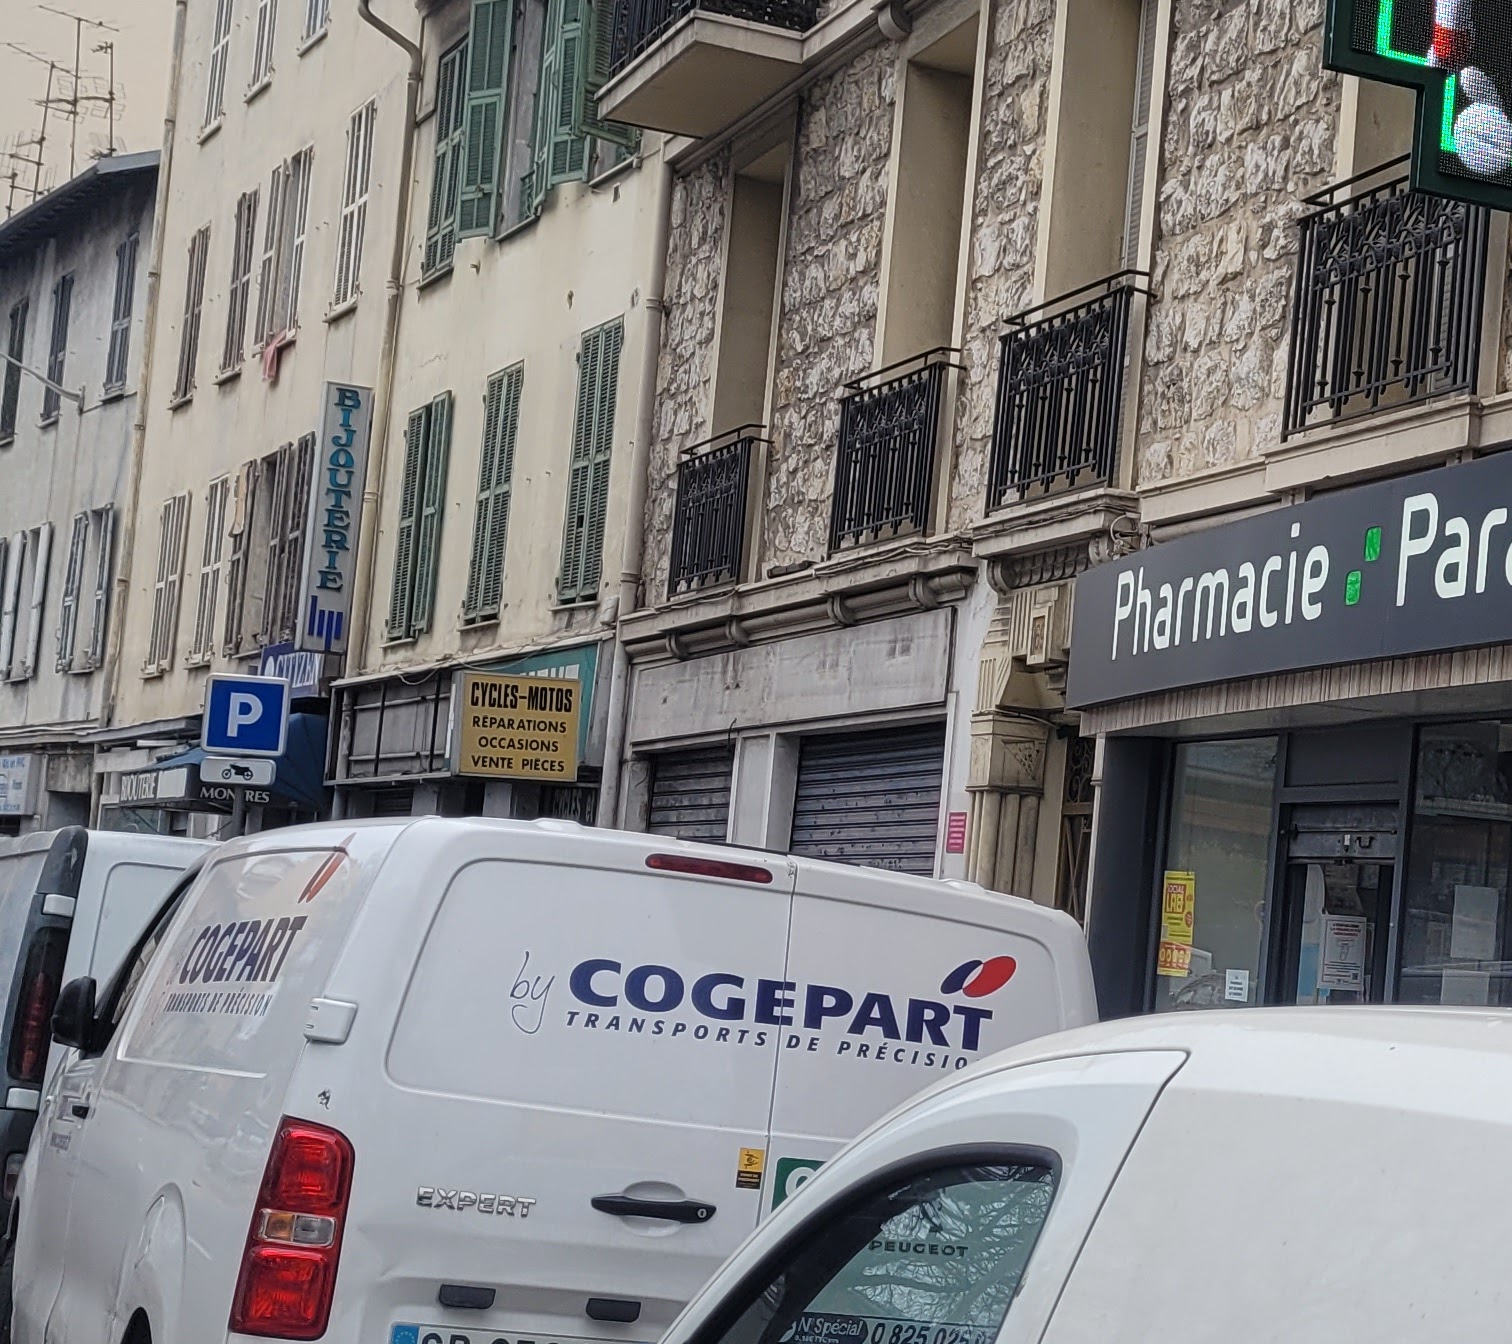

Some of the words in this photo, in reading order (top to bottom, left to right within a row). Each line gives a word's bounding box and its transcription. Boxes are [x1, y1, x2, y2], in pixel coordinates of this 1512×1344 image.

[316, 387, 361, 593] BIJOUTERIE
[1111, 522, 1328, 661] Pharmacie
[470, 681, 573, 713] CYCLES-MOTOS
[226, 691, 263, 738] P
[472, 715, 567, 733] RÉPARATIONS
[478, 736, 559, 753] OCCASIONS
[471, 754, 514, 770] VENTE
[120, 772, 157, 802] BIJOUTERIE
[200, 786, 271, 804] MONRES
[178, 915, 309, 985] COGEPART
[509, 950, 556, 1035] by
[569, 958, 994, 1052] COGEPART
[565, 1010, 768, 1047] TRANSPORTS
[785, 1033, 821, 1052] DE
[836, 1041, 979, 1071] PRÉCISIO
[416, 1186, 537, 1218] EXPERT
[868, 1240, 969, 1257] PEUGEOT
